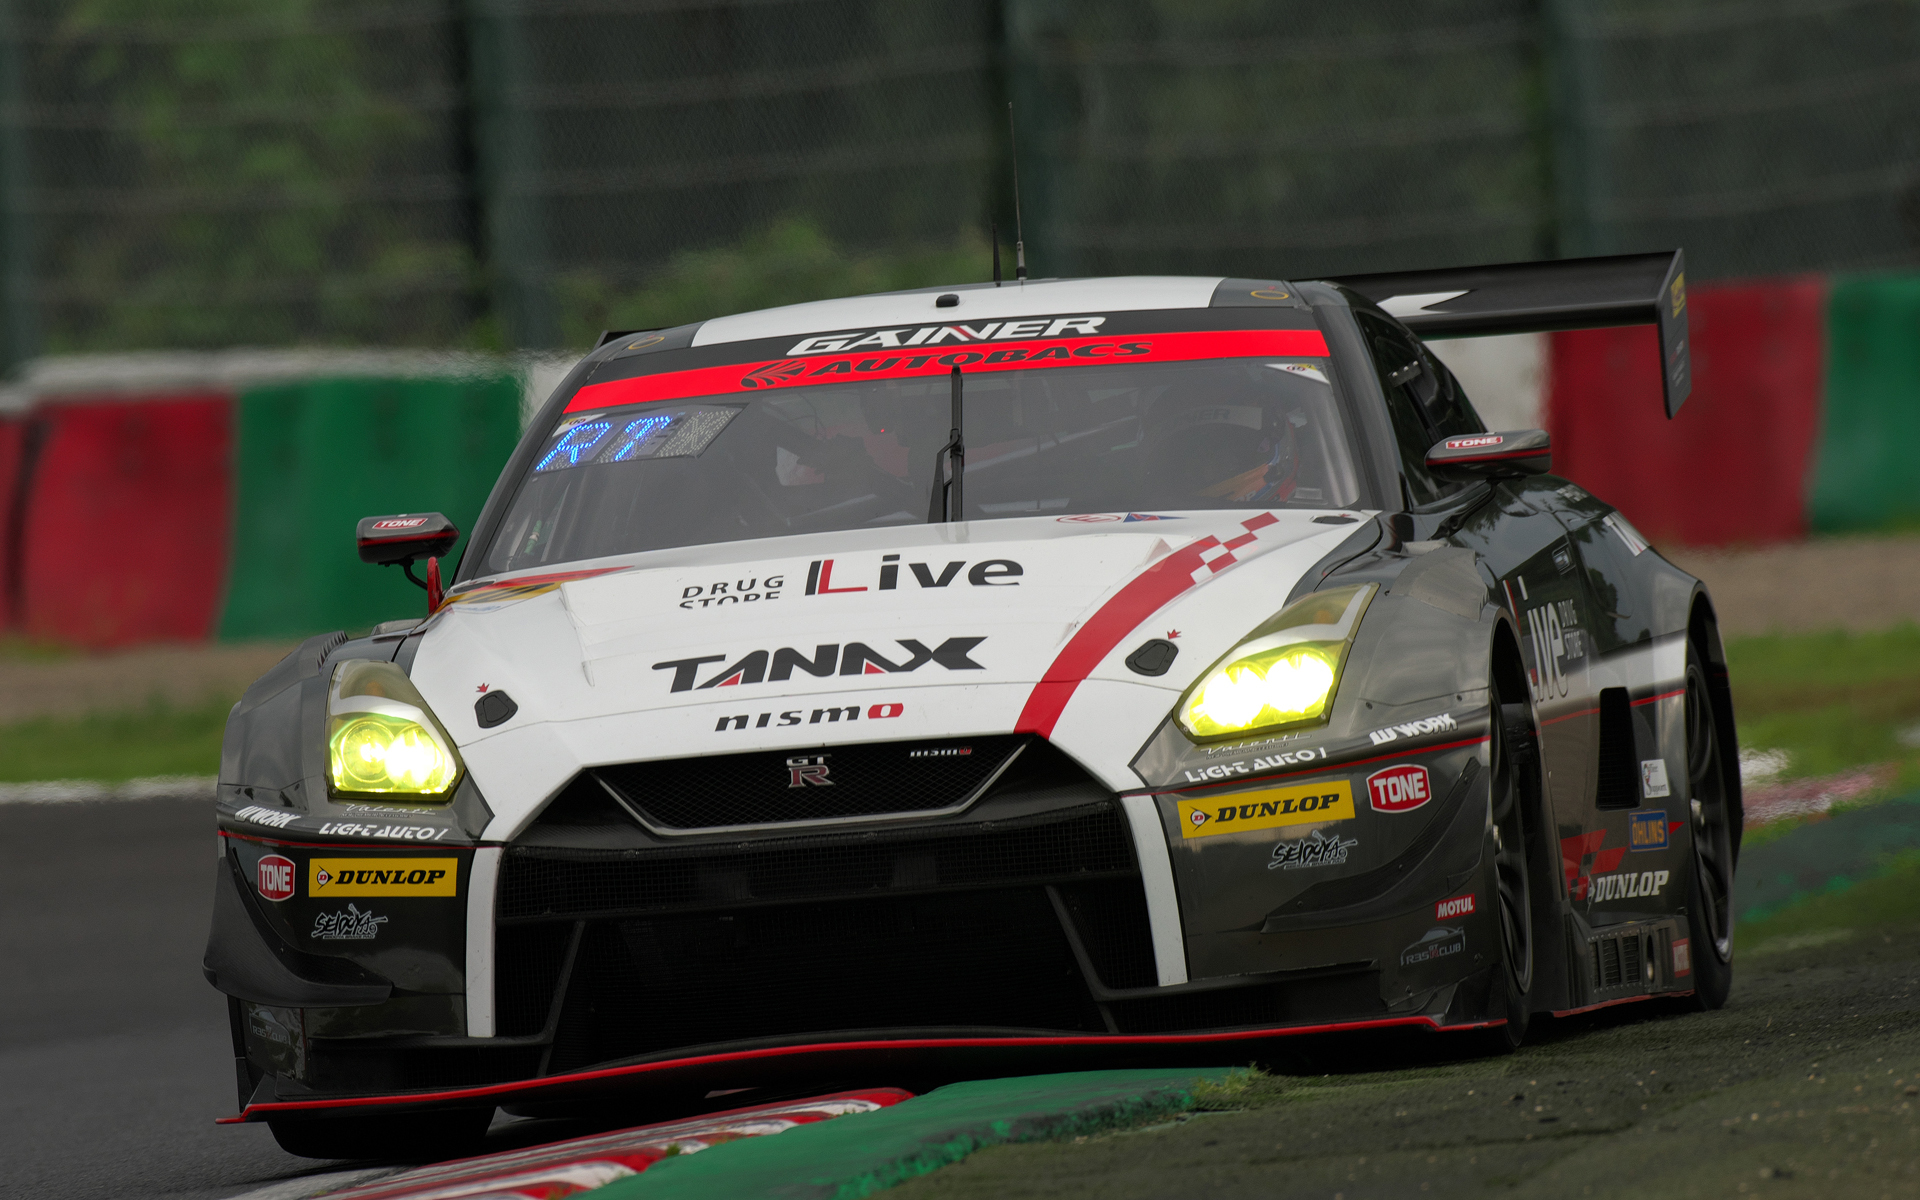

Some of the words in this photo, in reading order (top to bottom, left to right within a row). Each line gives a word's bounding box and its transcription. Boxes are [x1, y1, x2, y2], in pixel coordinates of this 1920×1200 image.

[786, 316, 1106, 356] GAINER
[805, 342, 1153, 377] AUTOBACS
[1450, 436, 1499, 448] TONE
[379, 518, 422, 528] TONE
[682, 575, 784, 599] DRUG
[652, 635, 988, 693] TANAX
[715, 702, 904, 732] nismo
[1393, 712, 1458, 738] WORK
[1253, 749, 1316, 771] AUTO
[1373, 771, 1427, 805] TONE
[1215, 793, 1340, 824] DUNLOP
[373, 825, 435, 840] AUTO
[260, 863, 291, 893] TONE
[335, 869, 446, 885] DUNLOP
[1594, 869, 1670, 903] DUNLOP
[1437, 896, 1474, 919] MOTUL
[1439, 942, 1462, 957] CLUB
